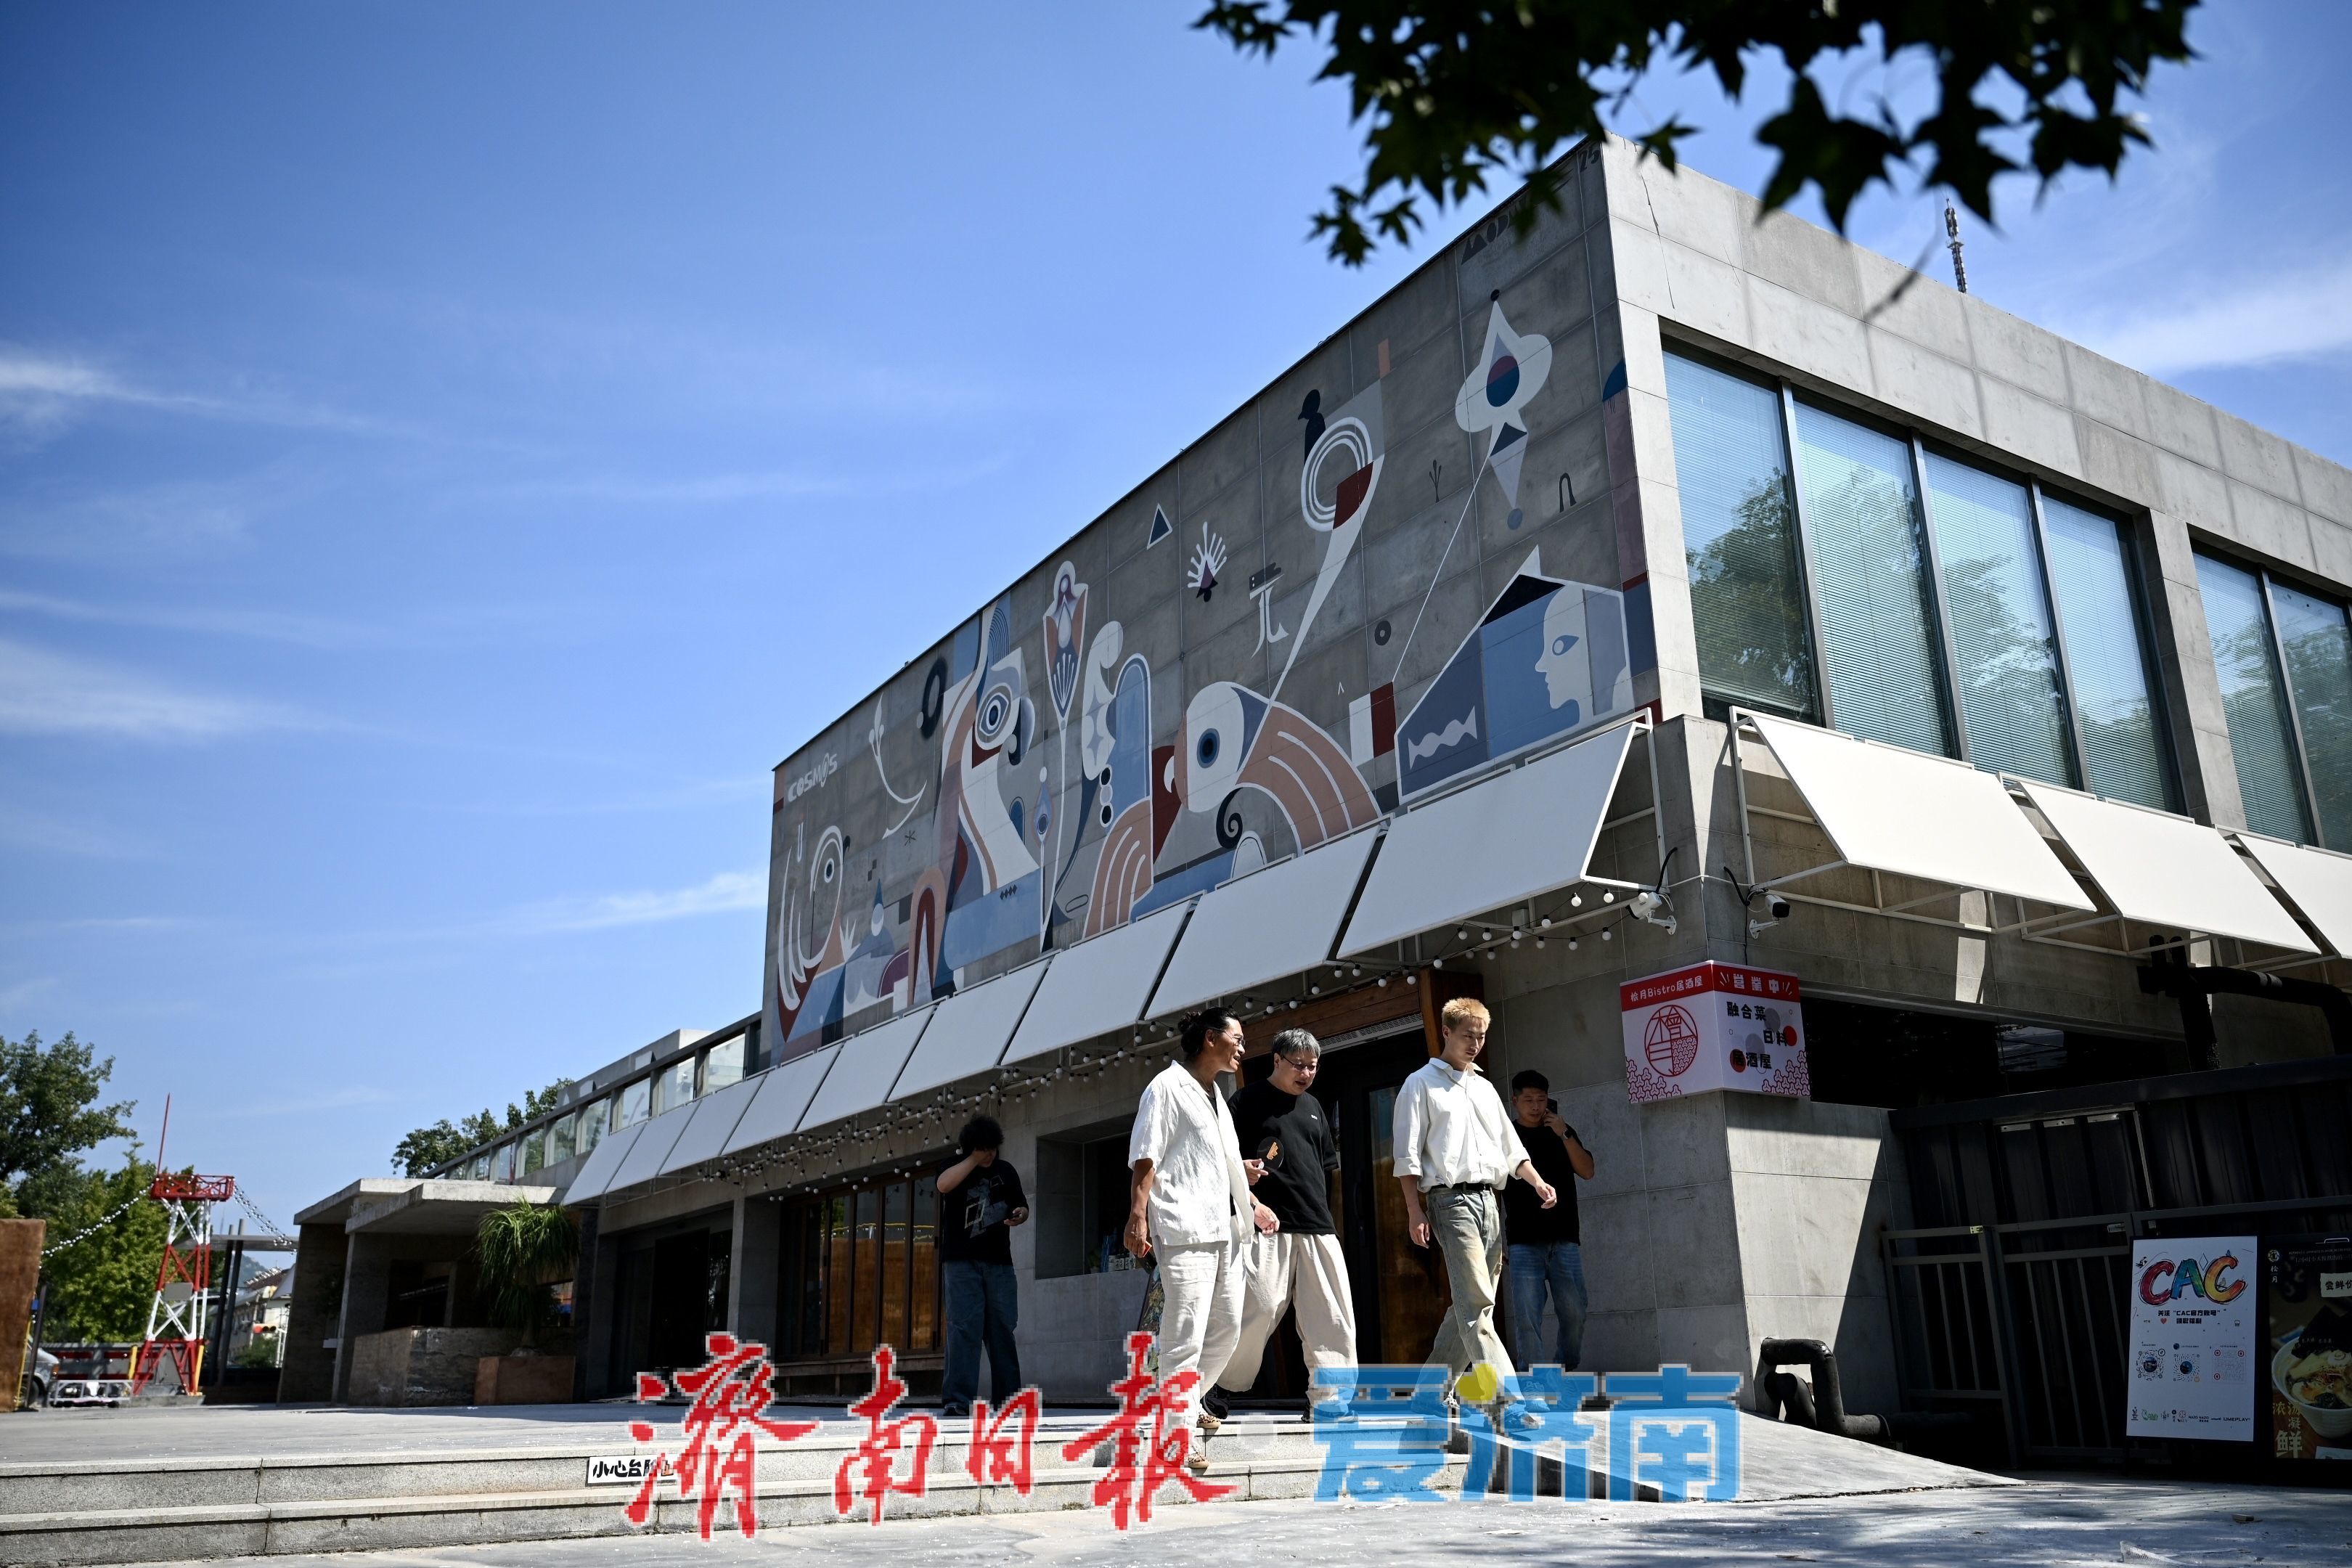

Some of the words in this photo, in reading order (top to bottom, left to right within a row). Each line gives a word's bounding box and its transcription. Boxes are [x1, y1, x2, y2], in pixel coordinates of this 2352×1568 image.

[788, 752, 838, 802] COSMOS
[1726, 1001, 1766, 1022] 融合菜
[1763, 1029, 1788, 1047] 日料
[1734, 1051, 1772, 1070] 居酒屋
[2140, 1255, 2248, 1305] CAC
